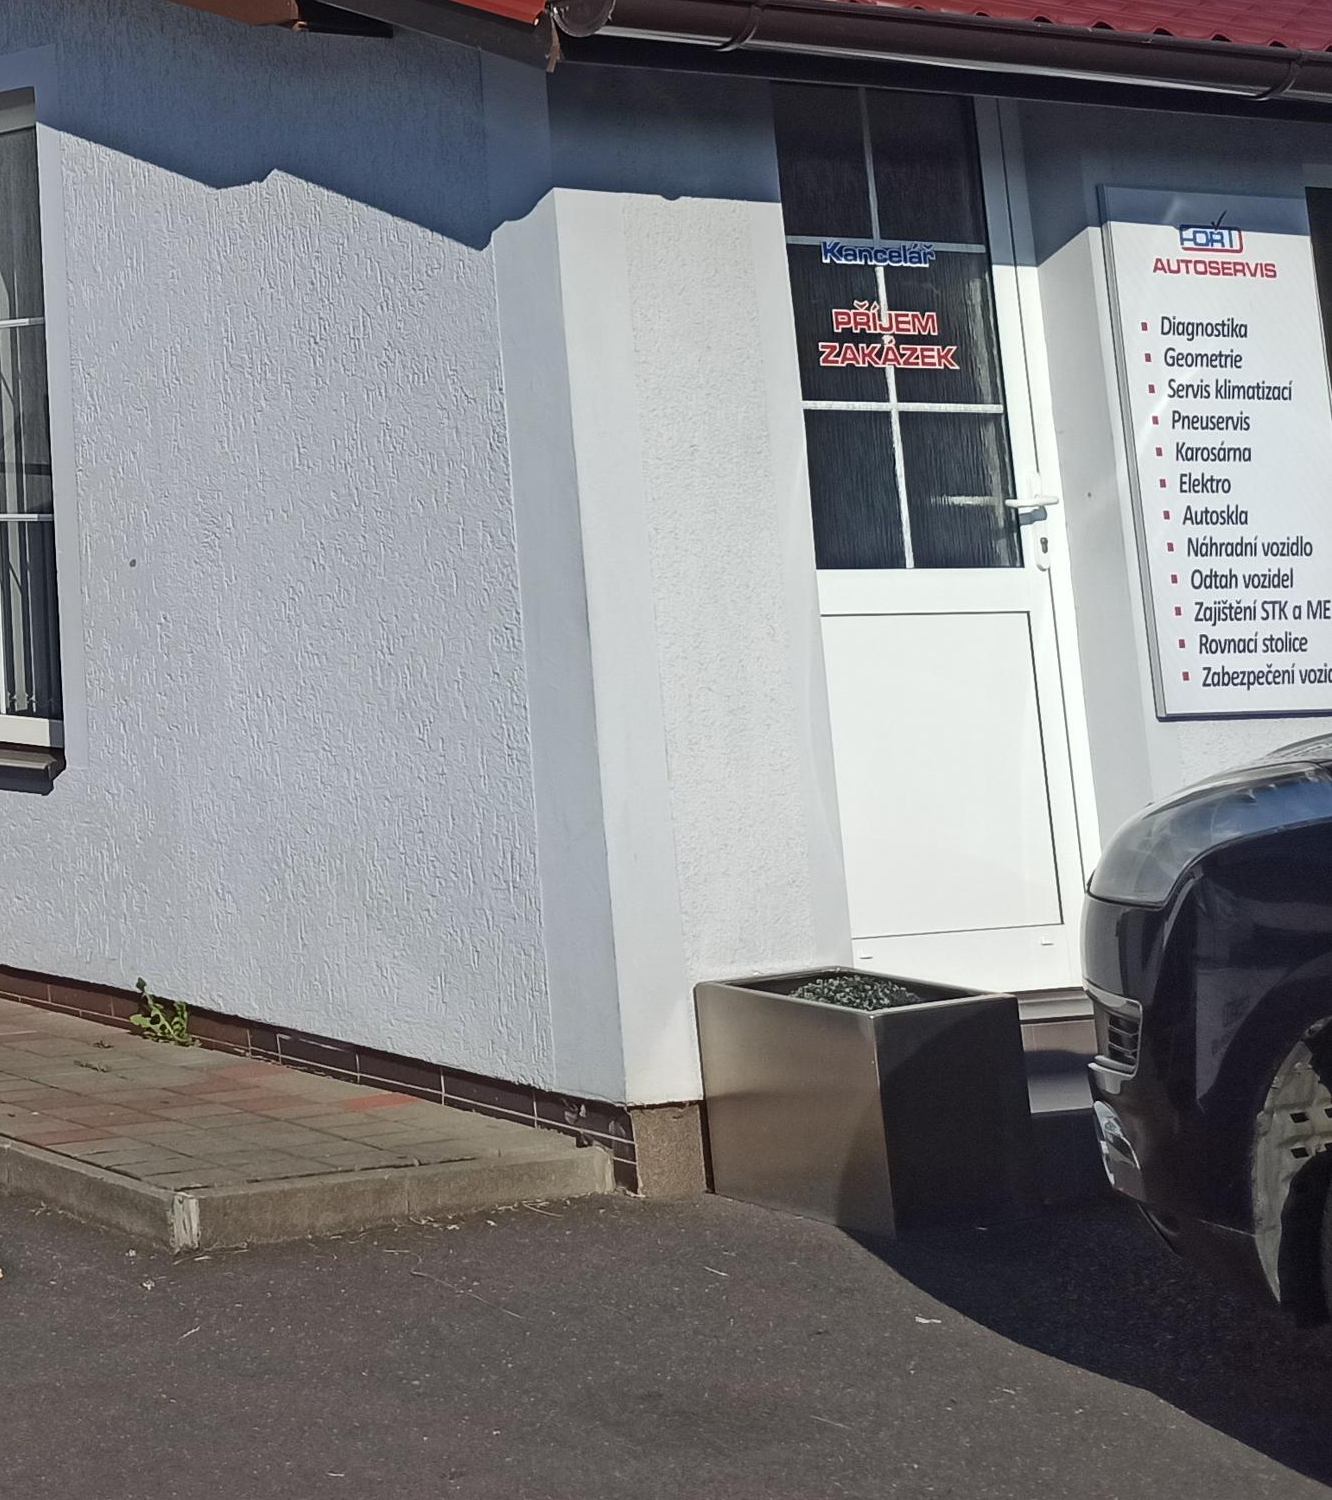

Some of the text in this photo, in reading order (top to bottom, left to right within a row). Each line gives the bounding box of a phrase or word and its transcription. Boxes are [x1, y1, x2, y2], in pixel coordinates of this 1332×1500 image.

[1179, 224, 1244, 253] FORT
[822, 241, 936, 268] Kancelář
[1152, 258, 1277, 279] AUTOSERVIS
[832, 300, 938, 336] PŘÍJEM
[1160, 316, 1248, 341] Diagnostika
[819, 336, 961, 369] ZAKÁZEK
[1164, 347, 1243, 369] Geometrie
[1167, 378, 1293, 401] Servis klimatizací
[1171, 410, 1251, 431] Pneuservis
[1175, 441, 1252, 462] Karosárna
[1179, 472, 1231, 493] Elektro
[1182, 504, 1249, 525] Autoskla
[1187, 535, 1313, 557] Náhradní vozidlo
[1191, 567, 1294, 590] Odtah vozidel
[1194, 599, 1332, 626] Zajištění STK a ME
[1199, 631, 1309, 655] Rovnací stolice
[1202, 663, 1295, 691] Zabezpečení
